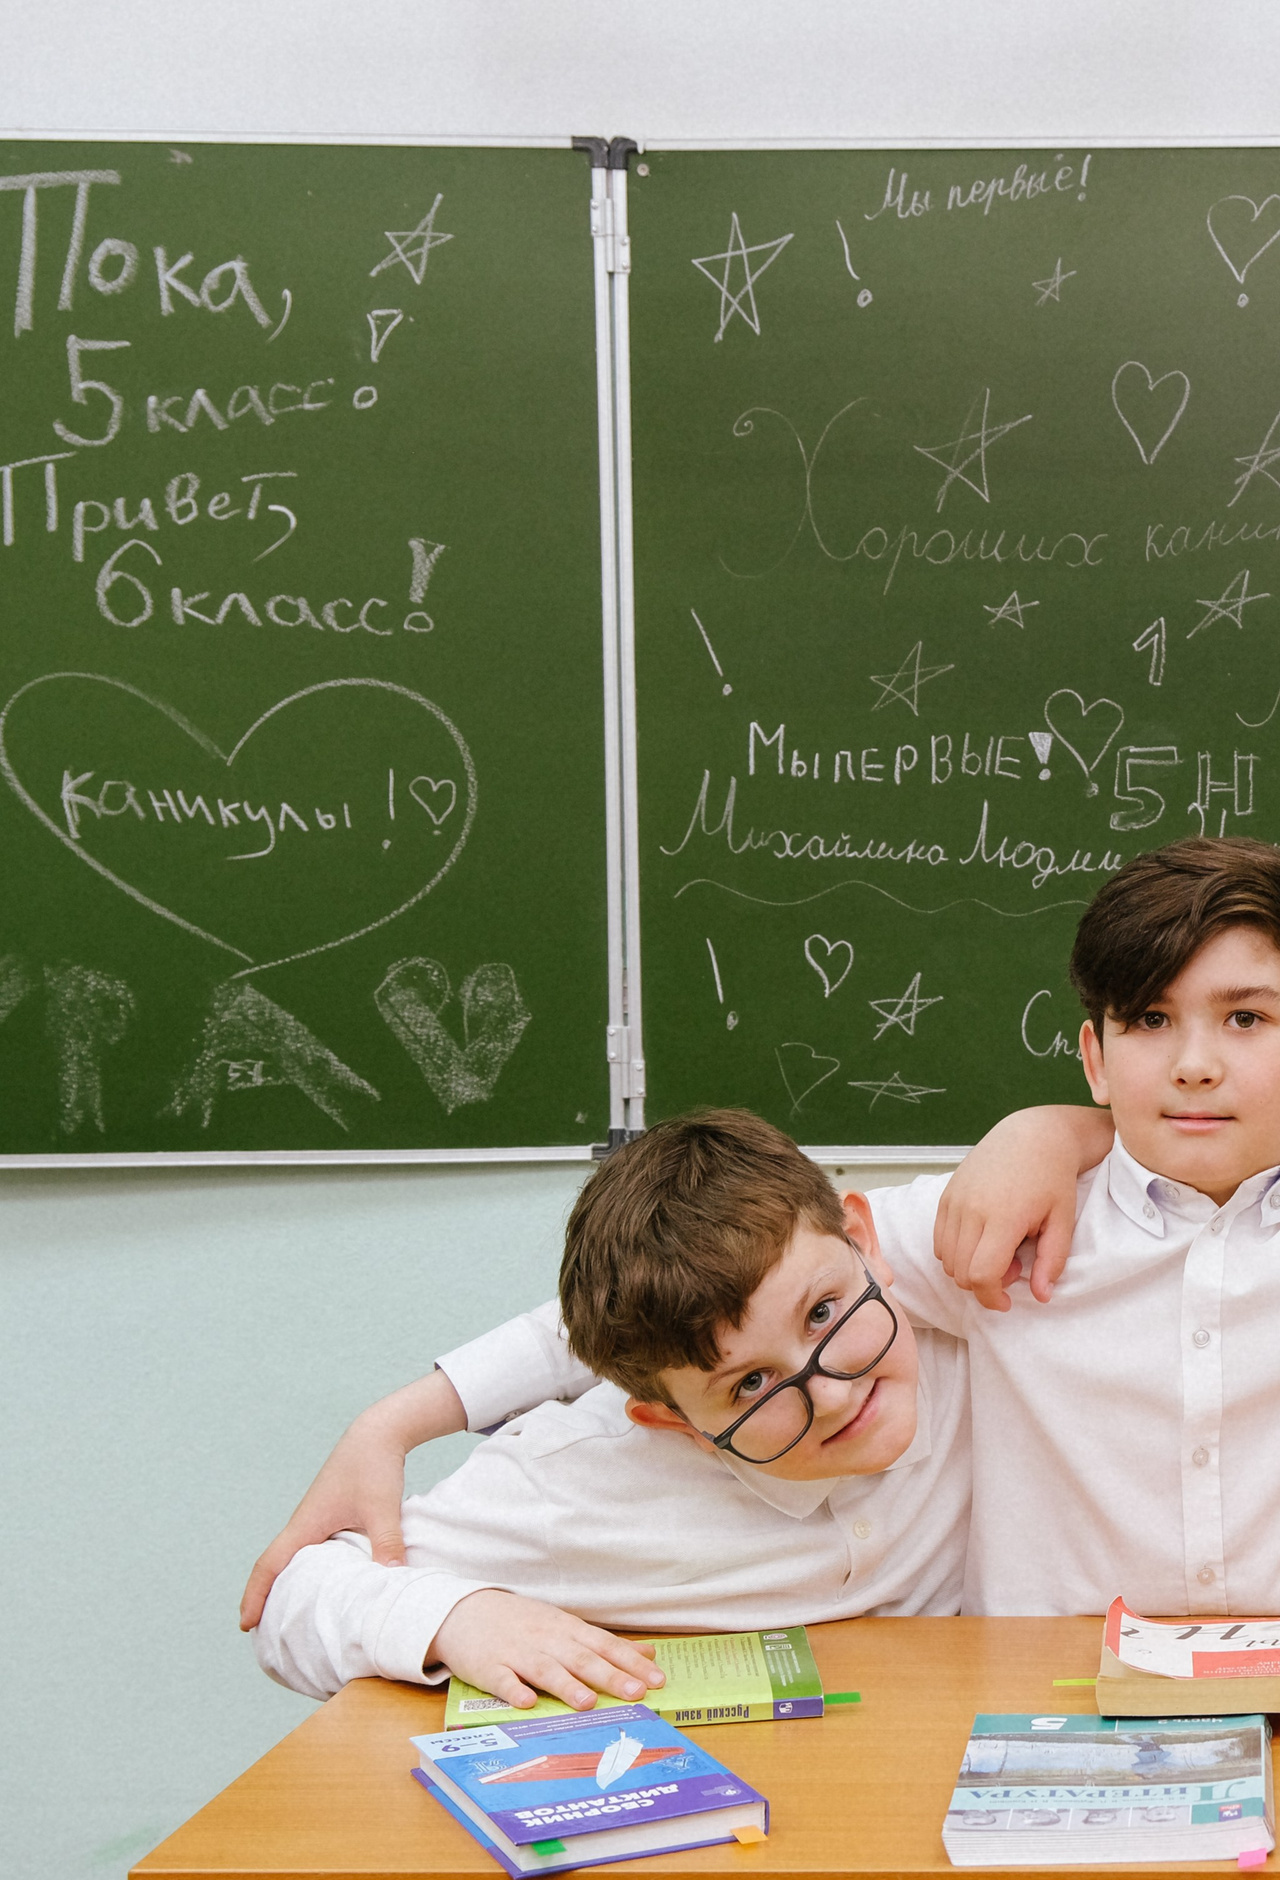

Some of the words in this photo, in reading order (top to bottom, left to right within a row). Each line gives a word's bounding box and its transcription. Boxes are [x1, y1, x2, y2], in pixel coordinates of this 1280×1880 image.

[864, 168, 933, 220] Мы
[0, 169, 292, 343] Пока,
[53, 334, 132, 446] 5
[0, 451, 298, 563] Привет,
[719, 396, 1109, 596] Хороших
[96, 539, 162, 627] 6
[959, 800, 1141, 889] Людми
[675, 1709, 702, 1721] язык
[706, 1704, 750, 1721] Русский
[1030, 1717, 1068, 1730] 5
[514, 1783, 679, 1821] ДИКТАНТОВ
[525, 1799, 655, 1828] СБОРНИК
